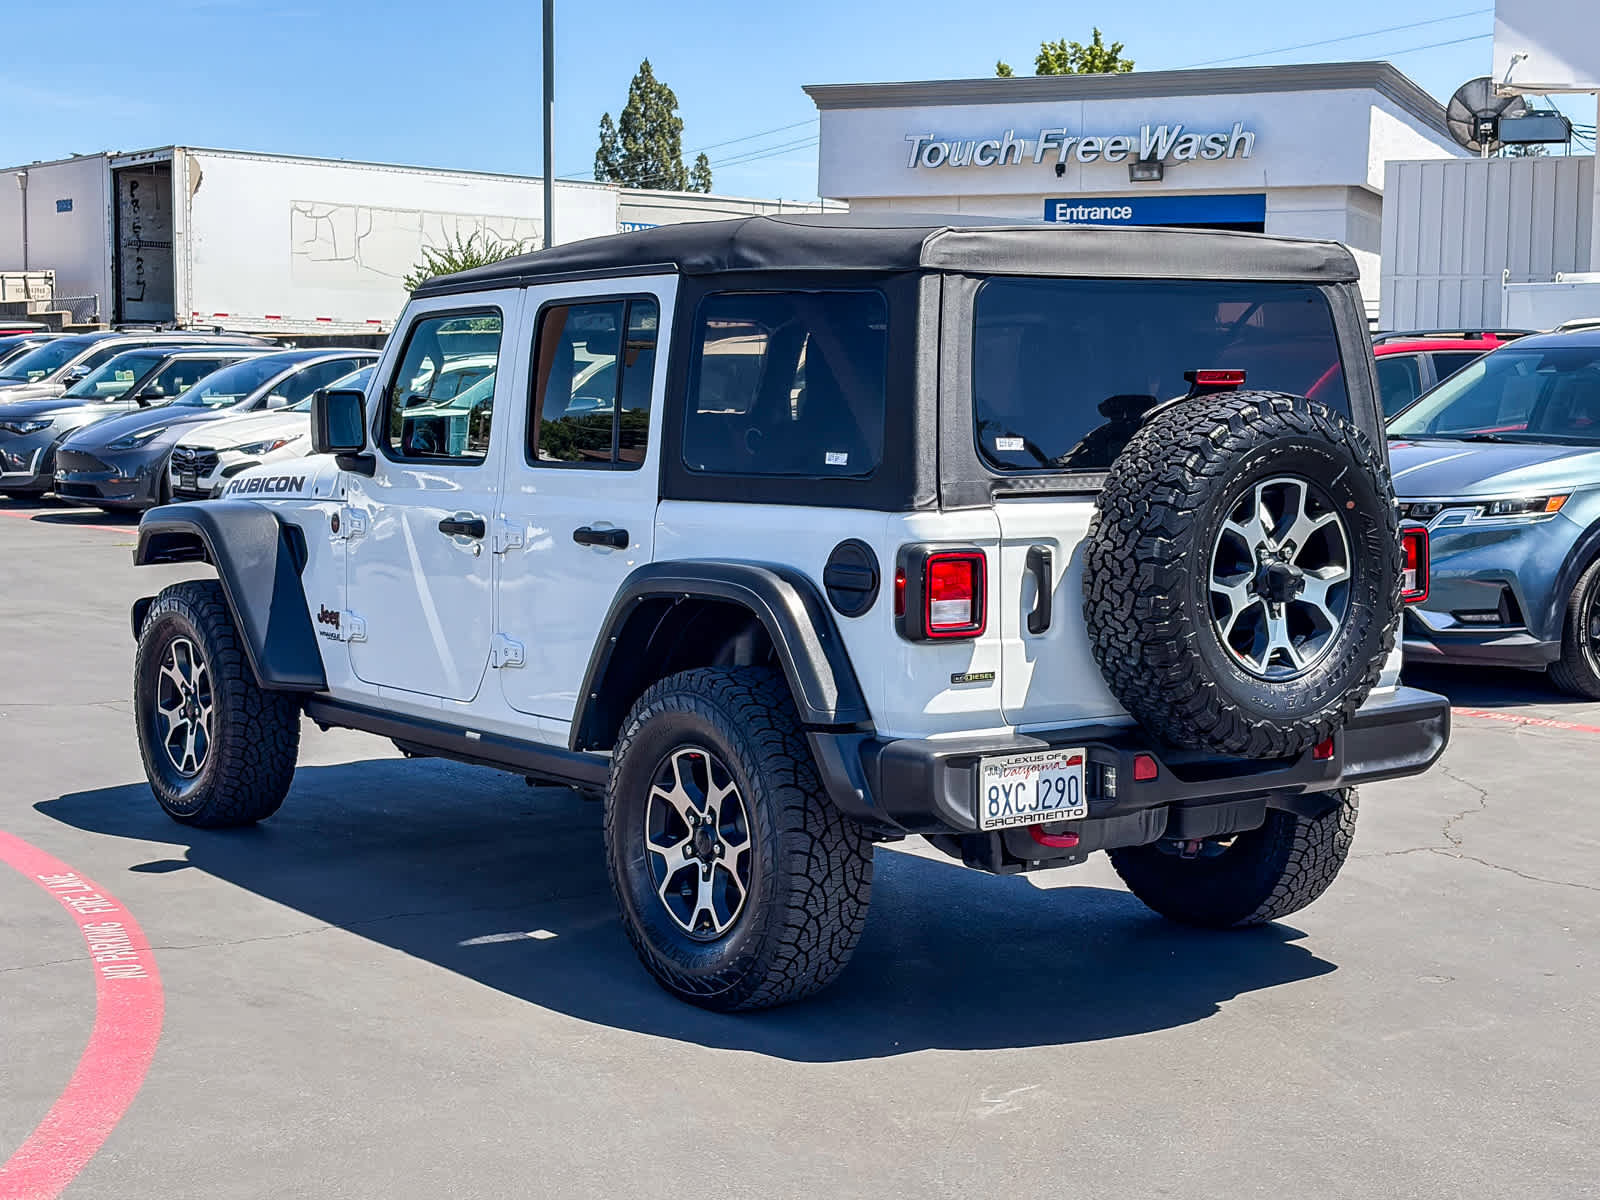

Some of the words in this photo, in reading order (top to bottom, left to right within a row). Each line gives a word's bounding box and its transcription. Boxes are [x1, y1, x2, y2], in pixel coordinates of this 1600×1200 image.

[904, 127, 1025, 169] Touch
[1033, 127, 1131, 164] Free
[1139, 122, 1256, 162] Wash
[1055, 203, 1133, 221] Entrance
[226, 476, 306, 494] RUBICON
[1007, 755, 1044, 765] LEXUS
[1046, 753, 1062, 761] OF
[1003, 762, 1067, 779] California
[988, 775, 1079, 817] 8XCJ290
[985, 808, 1084, 829] SACRAMENTO
[37, 872, 94, 894] LANE
[63, 893, 121, 915] FIRE
[83, 921, 140, 963] PARKING
[100, 963, 149, 980] NO
